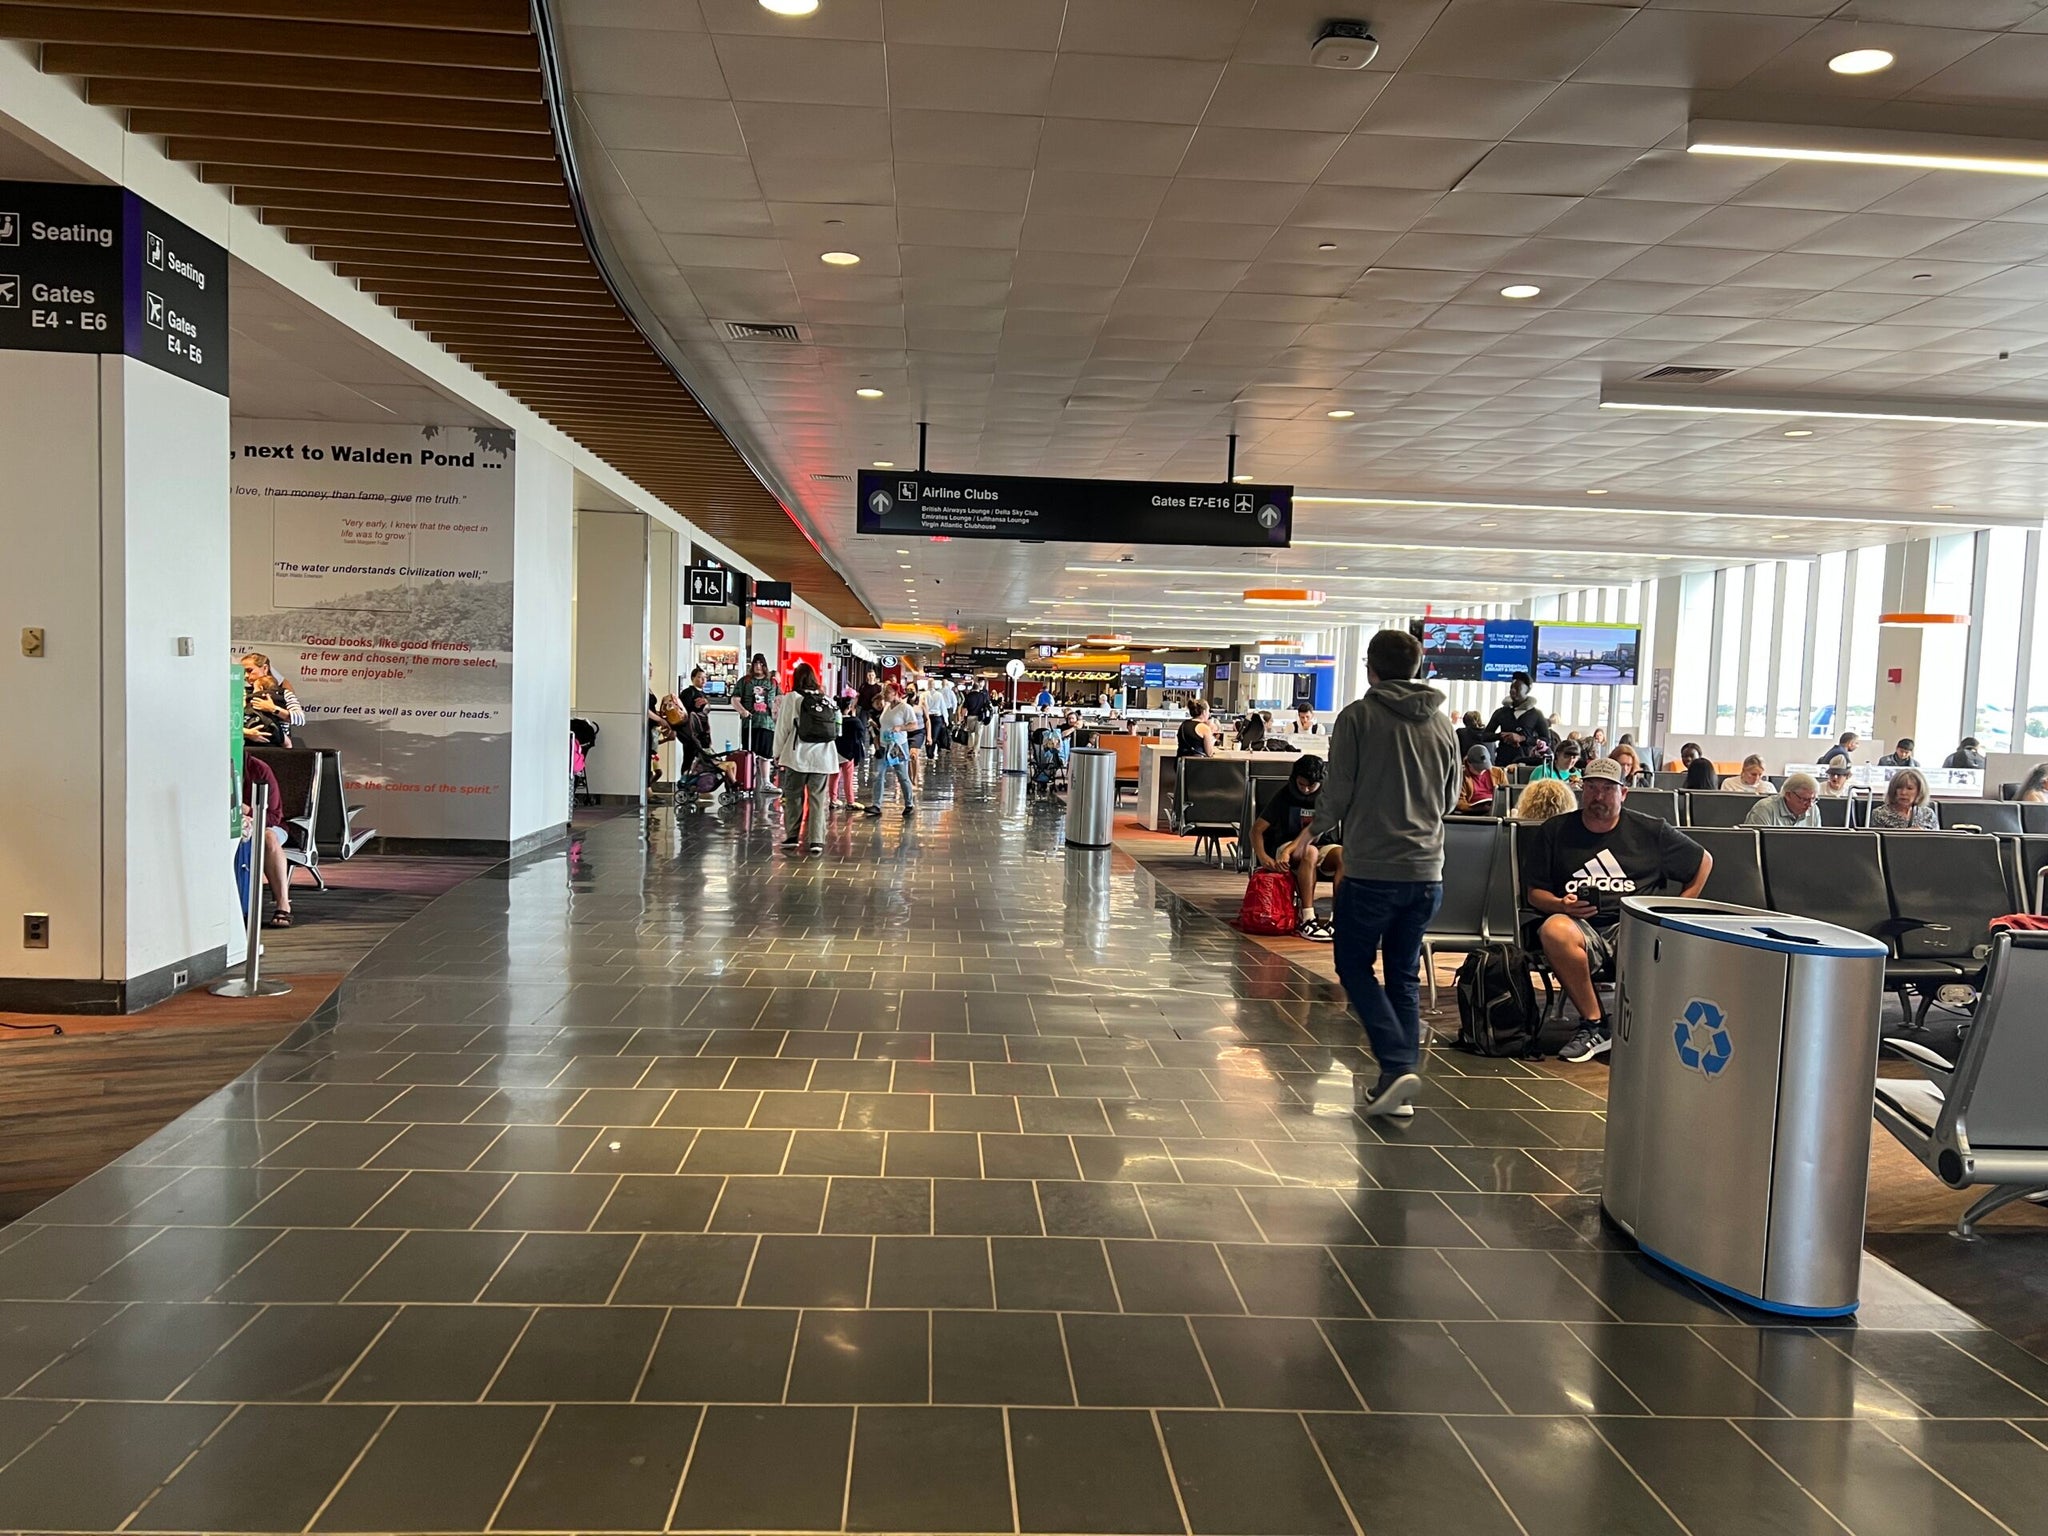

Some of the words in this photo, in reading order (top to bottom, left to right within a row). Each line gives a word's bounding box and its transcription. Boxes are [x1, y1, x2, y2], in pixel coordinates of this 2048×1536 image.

[32, 221, 112, 247] Seating
[168, 251, 205, 290] Seating
[32, 283, 95, 304] Gates
[32, 310, 59, 328] E4
[80, 312, 107, 331] E6
[168, 310, 197, 338] Gates
[167, 334, 181, 355] E4
[189, 345, 203, 365] E6
[244, 444, 294, 459] next
[301, 445, 324, 460] to
[331, 445, 412, 464] Walden
[421, 450, 474, 467] Pond
[235, 485, 261, 497] love,
[264, 487, 288, 497] than
[290, 489, 329, 500] money,
[332, 490, 355, 500] than
[358, 491, 387, 502] fame,
[390, 494, 412, 504] give
[415, 495, 432, 503] me
[435, 495, 467, 504] truth."
[922, 487, 961, 499] Airline
[964, 488, 999, 500] Clubs
[1152, 495, 1186, 507] Gates
[1189, 497, 1230, 508] E7-E16
[1011, 509, 1023, 517] Sky
[341, 529, 353, 537] life
[374, 531, 383, 539] to
[342, 518, 363, 528] "Very
[366, 519, 387, 530] early,
[396, 521, 417, 529] knew
[420, 522, 436, 530] that
[437, 522, 451, 530] the
[453, 524, 479, 533] object
[964, 522, 996, 530] Clubhouse
[274, 562, 299, 572] "The
[301, 564, 329, 572] water
[332, 564, 396, 575] understands
[399, 566, 455, 578] Civilization
[458, 570, 488, 579] well;"
[301, 635, 336, 645] "Good
[339, 637, 375, 648] books,
[379, 638, 398, 648] like
[400, 641, 429, 651] good
[431, 640, 472, 652] friends,
[300, 652, 318, 660] are
[321, 651, 340, 660] few
[342, 653, 363, 662] and
[366, 653, 409, 664] chosen;
[412, 655, 429, 664] the
[432, 657, 460, 665] more
[463, 657, 498, 668] select,
[300, 665, 318, 675] the
[320, 668, 348, 676] more
[351, 667, 413, 680] enjoyable."
[343, 705, 362, 714] feet
[379, 707, 398, 716] well
[460, 710, 499, 719] heads."
[344, 782, 361, 790] ars
[364, 781, 383, 790] the
[385, 782, 420, 792] colors
[424, 783, 437, 793] of
[439, 784, 457, 793] the
[1565, 876, 1636, 893] adidas
